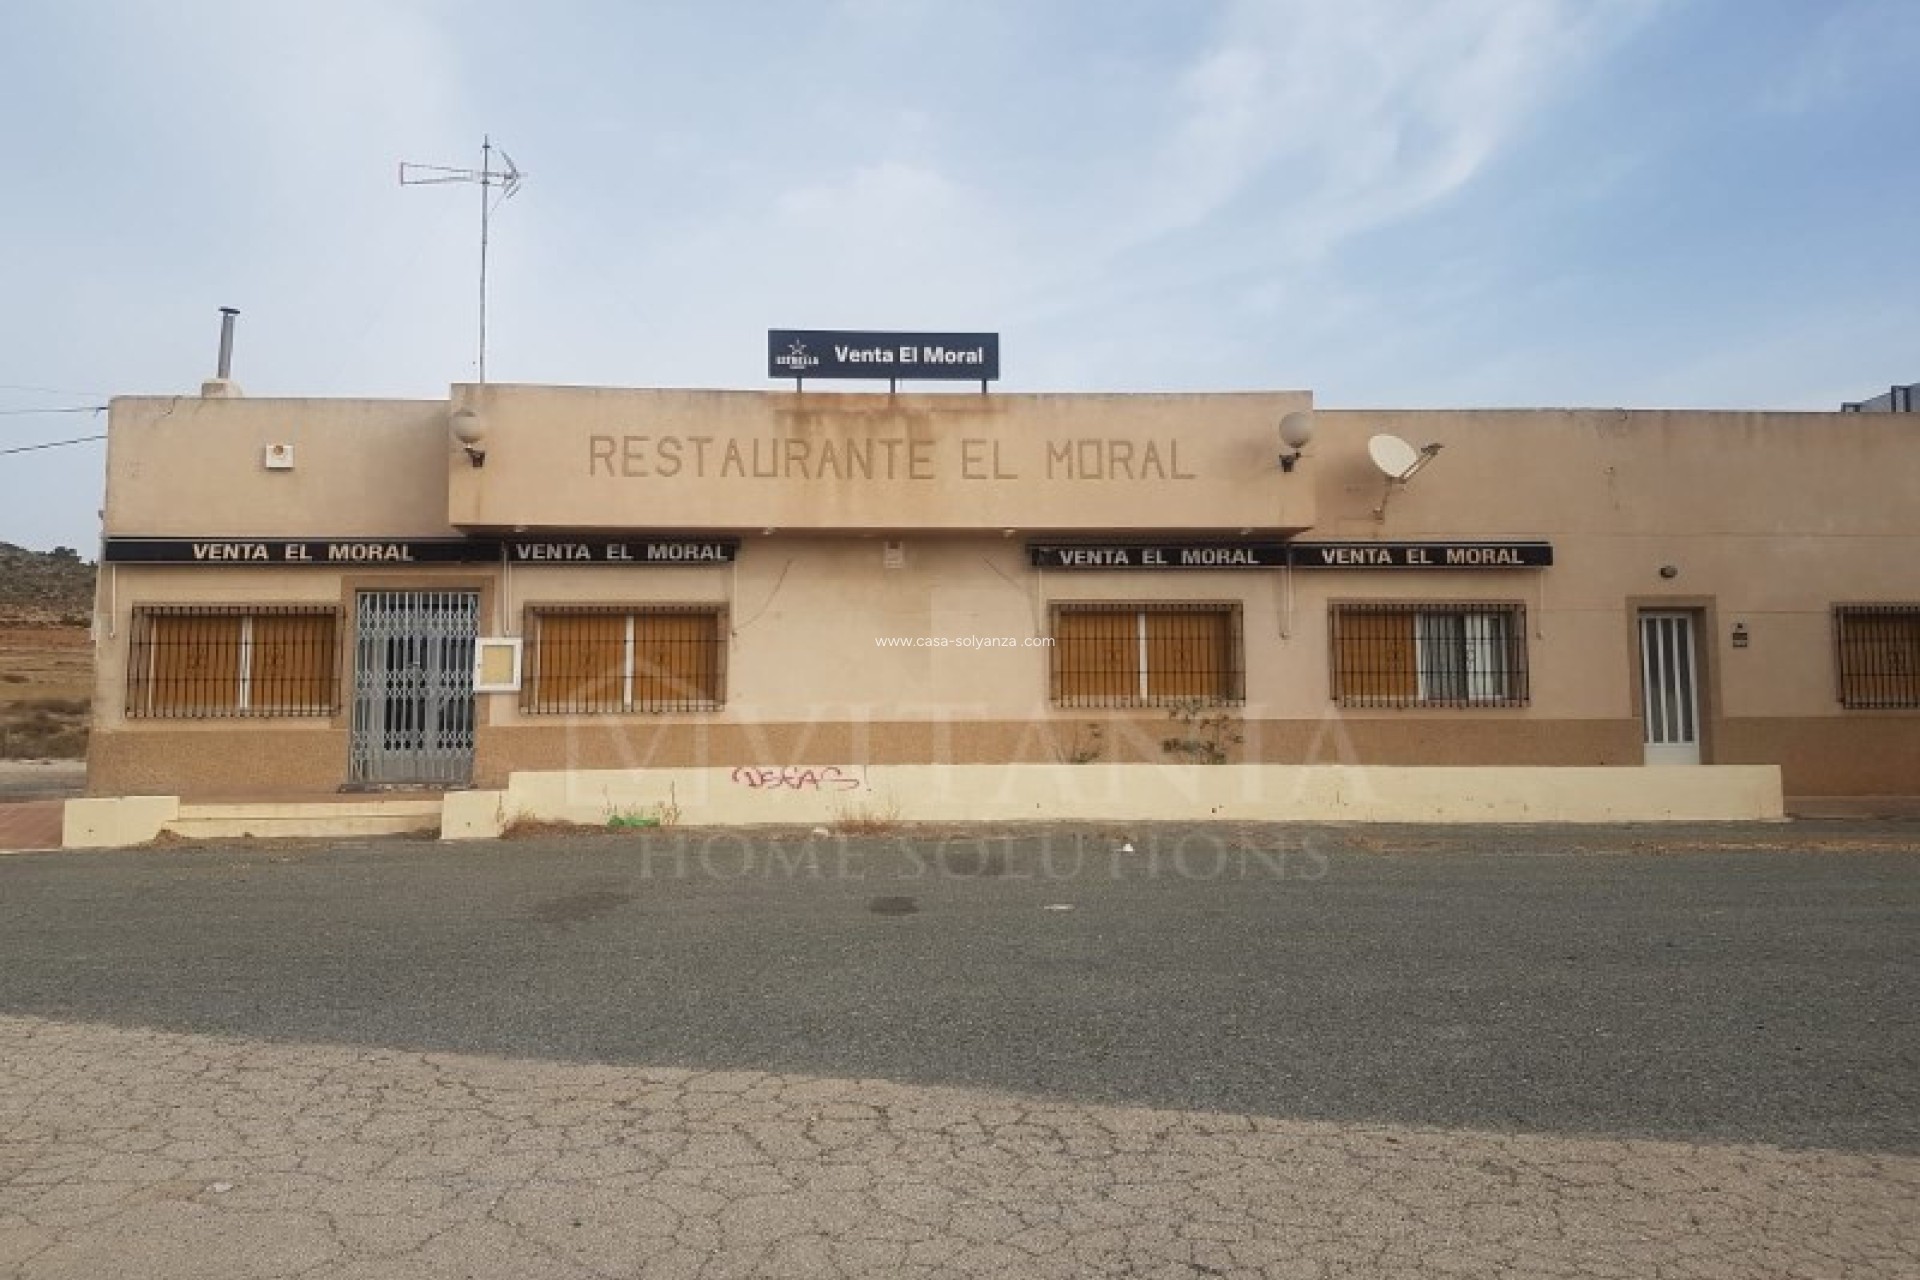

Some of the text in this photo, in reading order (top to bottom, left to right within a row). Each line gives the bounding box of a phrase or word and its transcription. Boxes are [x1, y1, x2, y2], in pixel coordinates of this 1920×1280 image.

[834, 346, 983, 364] Venta El Moral
[589, 435, 1196, 480] RESTAURANTE EL MORAL
[192, 543, 414, 561] VENTA EL MORAL
[515, 543, 728, 560] VENTA EL MORAL
[1059, 549, 1261, 565] VENTA EL MORAL
[1322, 548, 1525, 564] VENTA EL MORAL
